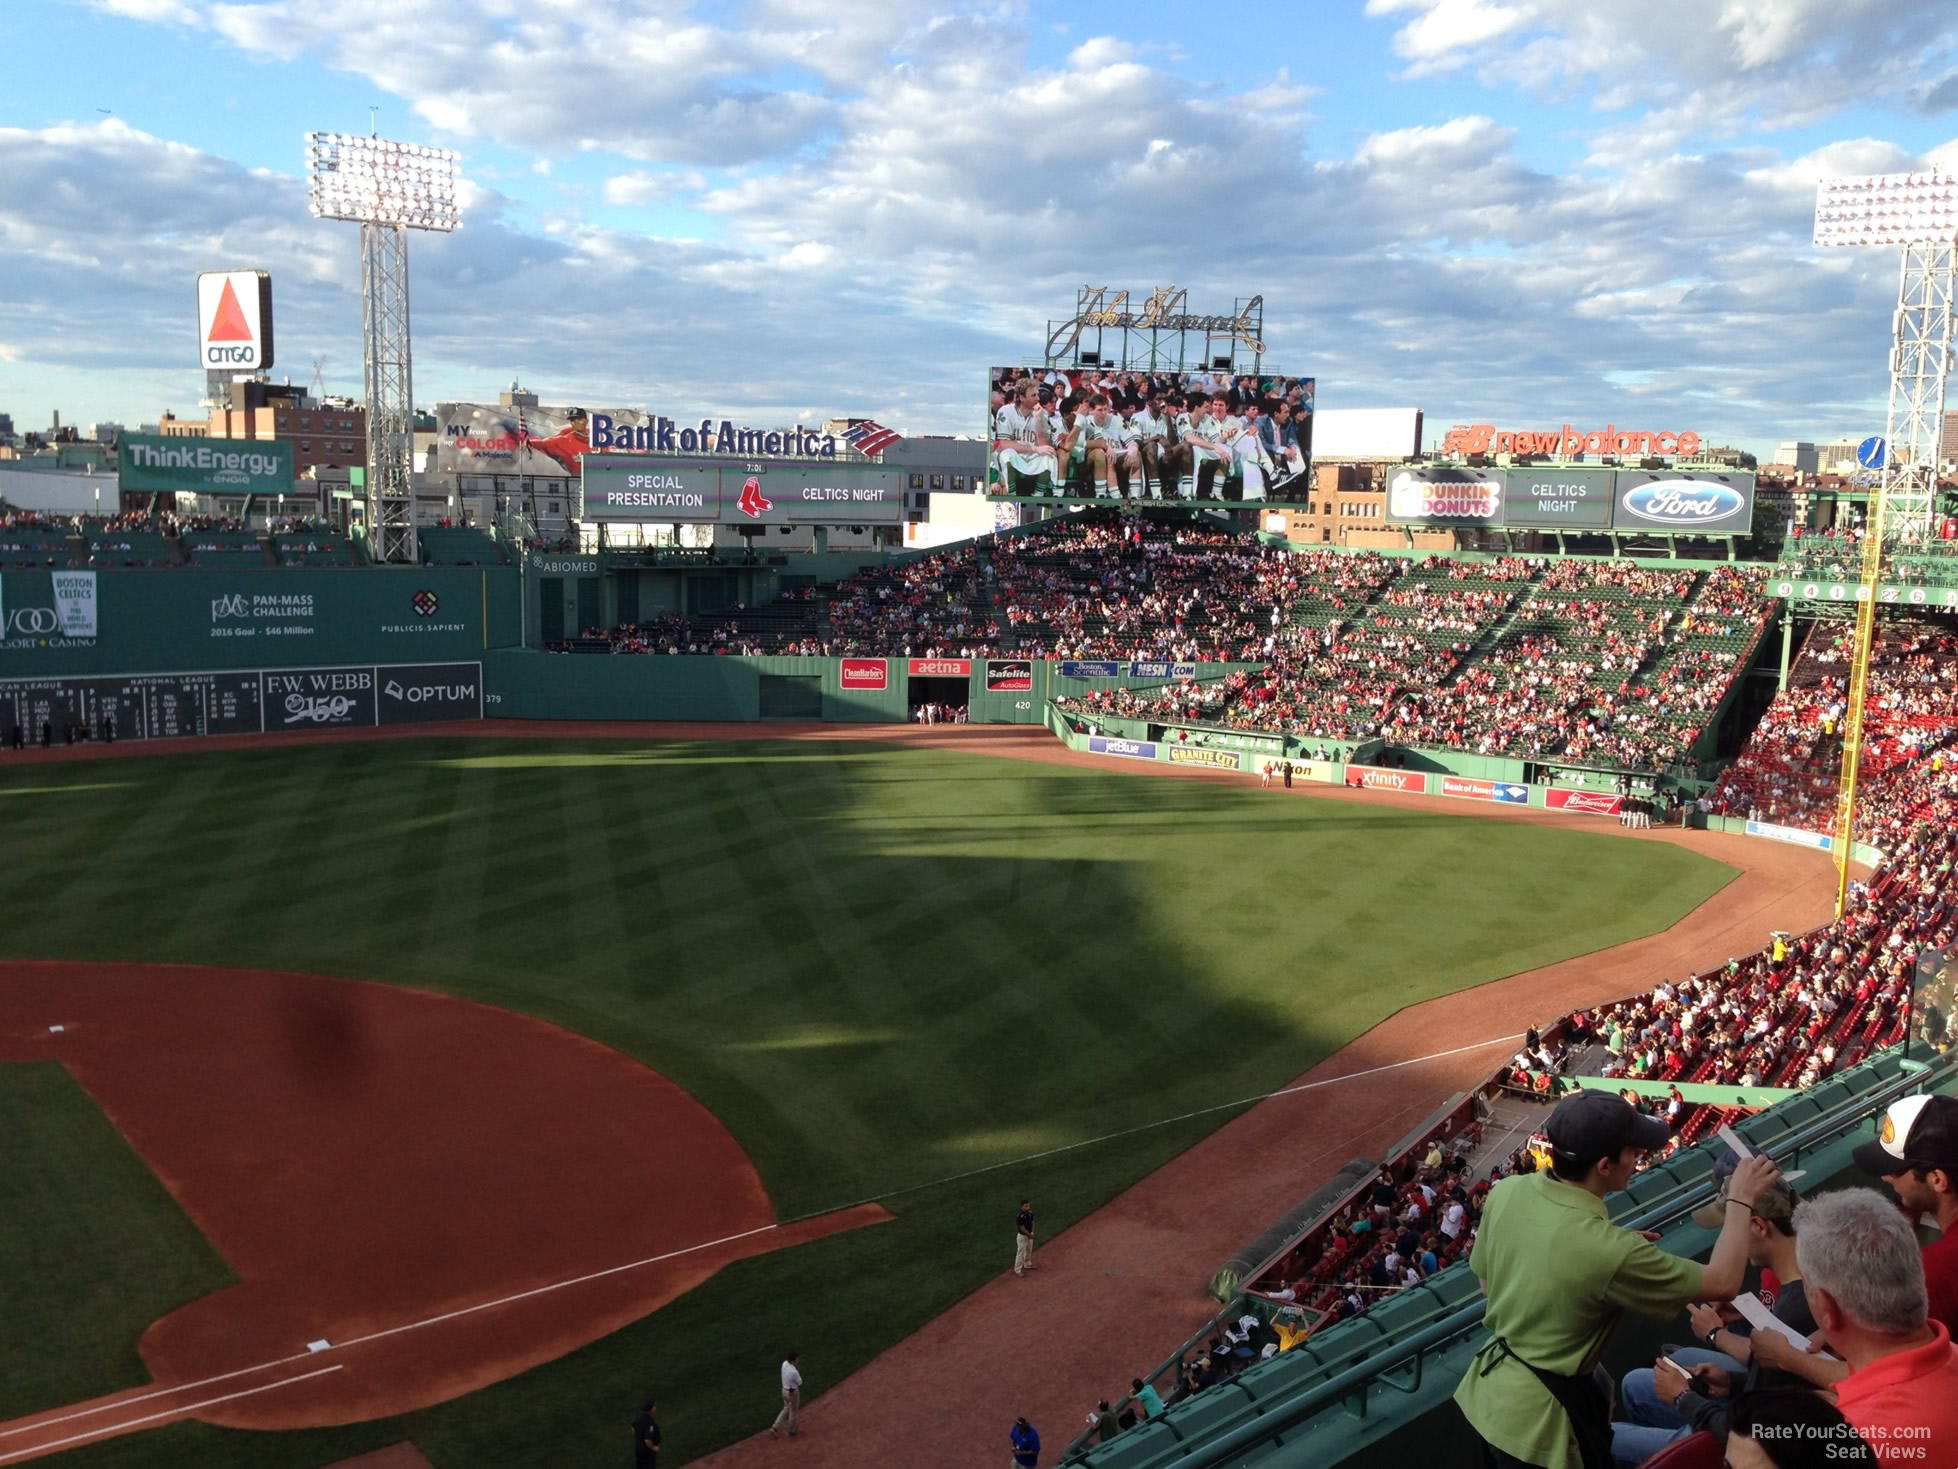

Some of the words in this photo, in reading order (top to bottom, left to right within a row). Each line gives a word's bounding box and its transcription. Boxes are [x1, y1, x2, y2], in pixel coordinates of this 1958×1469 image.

[208, 346, 254, 364] CITGO
[447, 425, 470, 437] MY
[590, 413, 677, 450] Bank
[679, 419, 711, 450] of
[714, 421, 836, 457] America
[746, 464, 762, 472] 7:01
[628, 476, 683, 489] SPECIAL
[607, 492, 703, 507] PRESENTATION
[1647, 485, 1718, 516] Ford
[1423, 500, 1491, 514] DONUTS
[1538, 500, 1577, 513] NIGHT
[544, 562, 597, 572] ABIOMED
[57, 578, 92, 588] BOSTON
[253, 595, 313, 605] PAN-MASS
[253, 607, 314, 616] CHALLENGE
[210, 628, 233, 637] 2016
[235, 627, 255, 636] Goal
[265, 627, 282, 635] $46
[284, 626, 314, 635] Million
[918, 661, 961, 674] aetna
[1073, 667, 1111, 676] Scientific
[1079, 662, 1103, 670] Boston
[1137, 663, 1167, 676] NESN
[179, 676, 215, 684] LEAGUE
[988, 669, 1030, 679] Safelite
[25, 682, 63, 690] LEAGUE
[267, 676, 304, 693] F.W.
[310, 673, 372, 691] WEBB
[407, 685, 474, 702] OPTUM
[485, 695, 501, 703] 379
[1015, 701, 1031, 710] 420
[1104, 739, 1140, 755] jetBlue
[1171, 749, 1214, 761] GRANITE
[1362, 771, 1407, 789] xfinity
[1444, 783, 1463, 793] Bank
[1463, 783, 1472, 793] of
[1472, 785, 1504, 797] America
[1567, 794, 1613, 809] Budweiser
